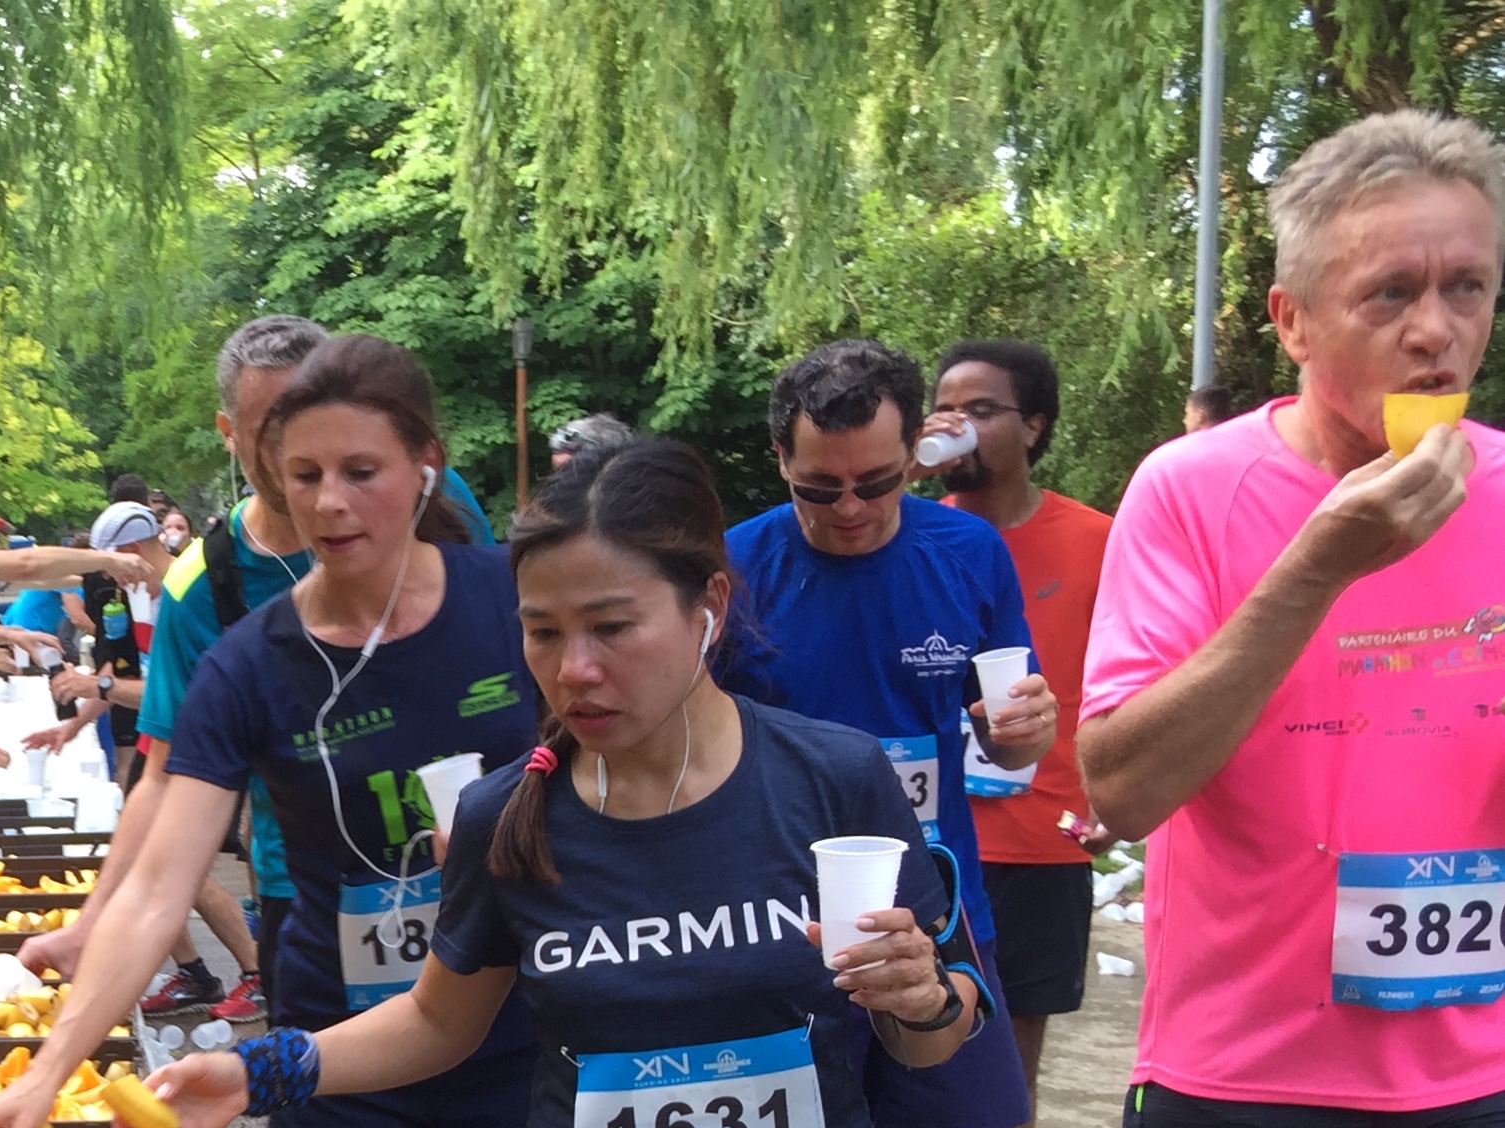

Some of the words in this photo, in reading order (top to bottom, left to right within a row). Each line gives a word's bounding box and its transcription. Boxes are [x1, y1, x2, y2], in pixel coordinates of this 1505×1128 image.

[1338, 629, 1428, 648] PARTENAIRE
[1433, 626, 1458, 640] DU
[1285, 720, 1344, 734] VINCI
[534, 894, 812, 974] GARMIN
[1366, 899, 1505, 957] 382
